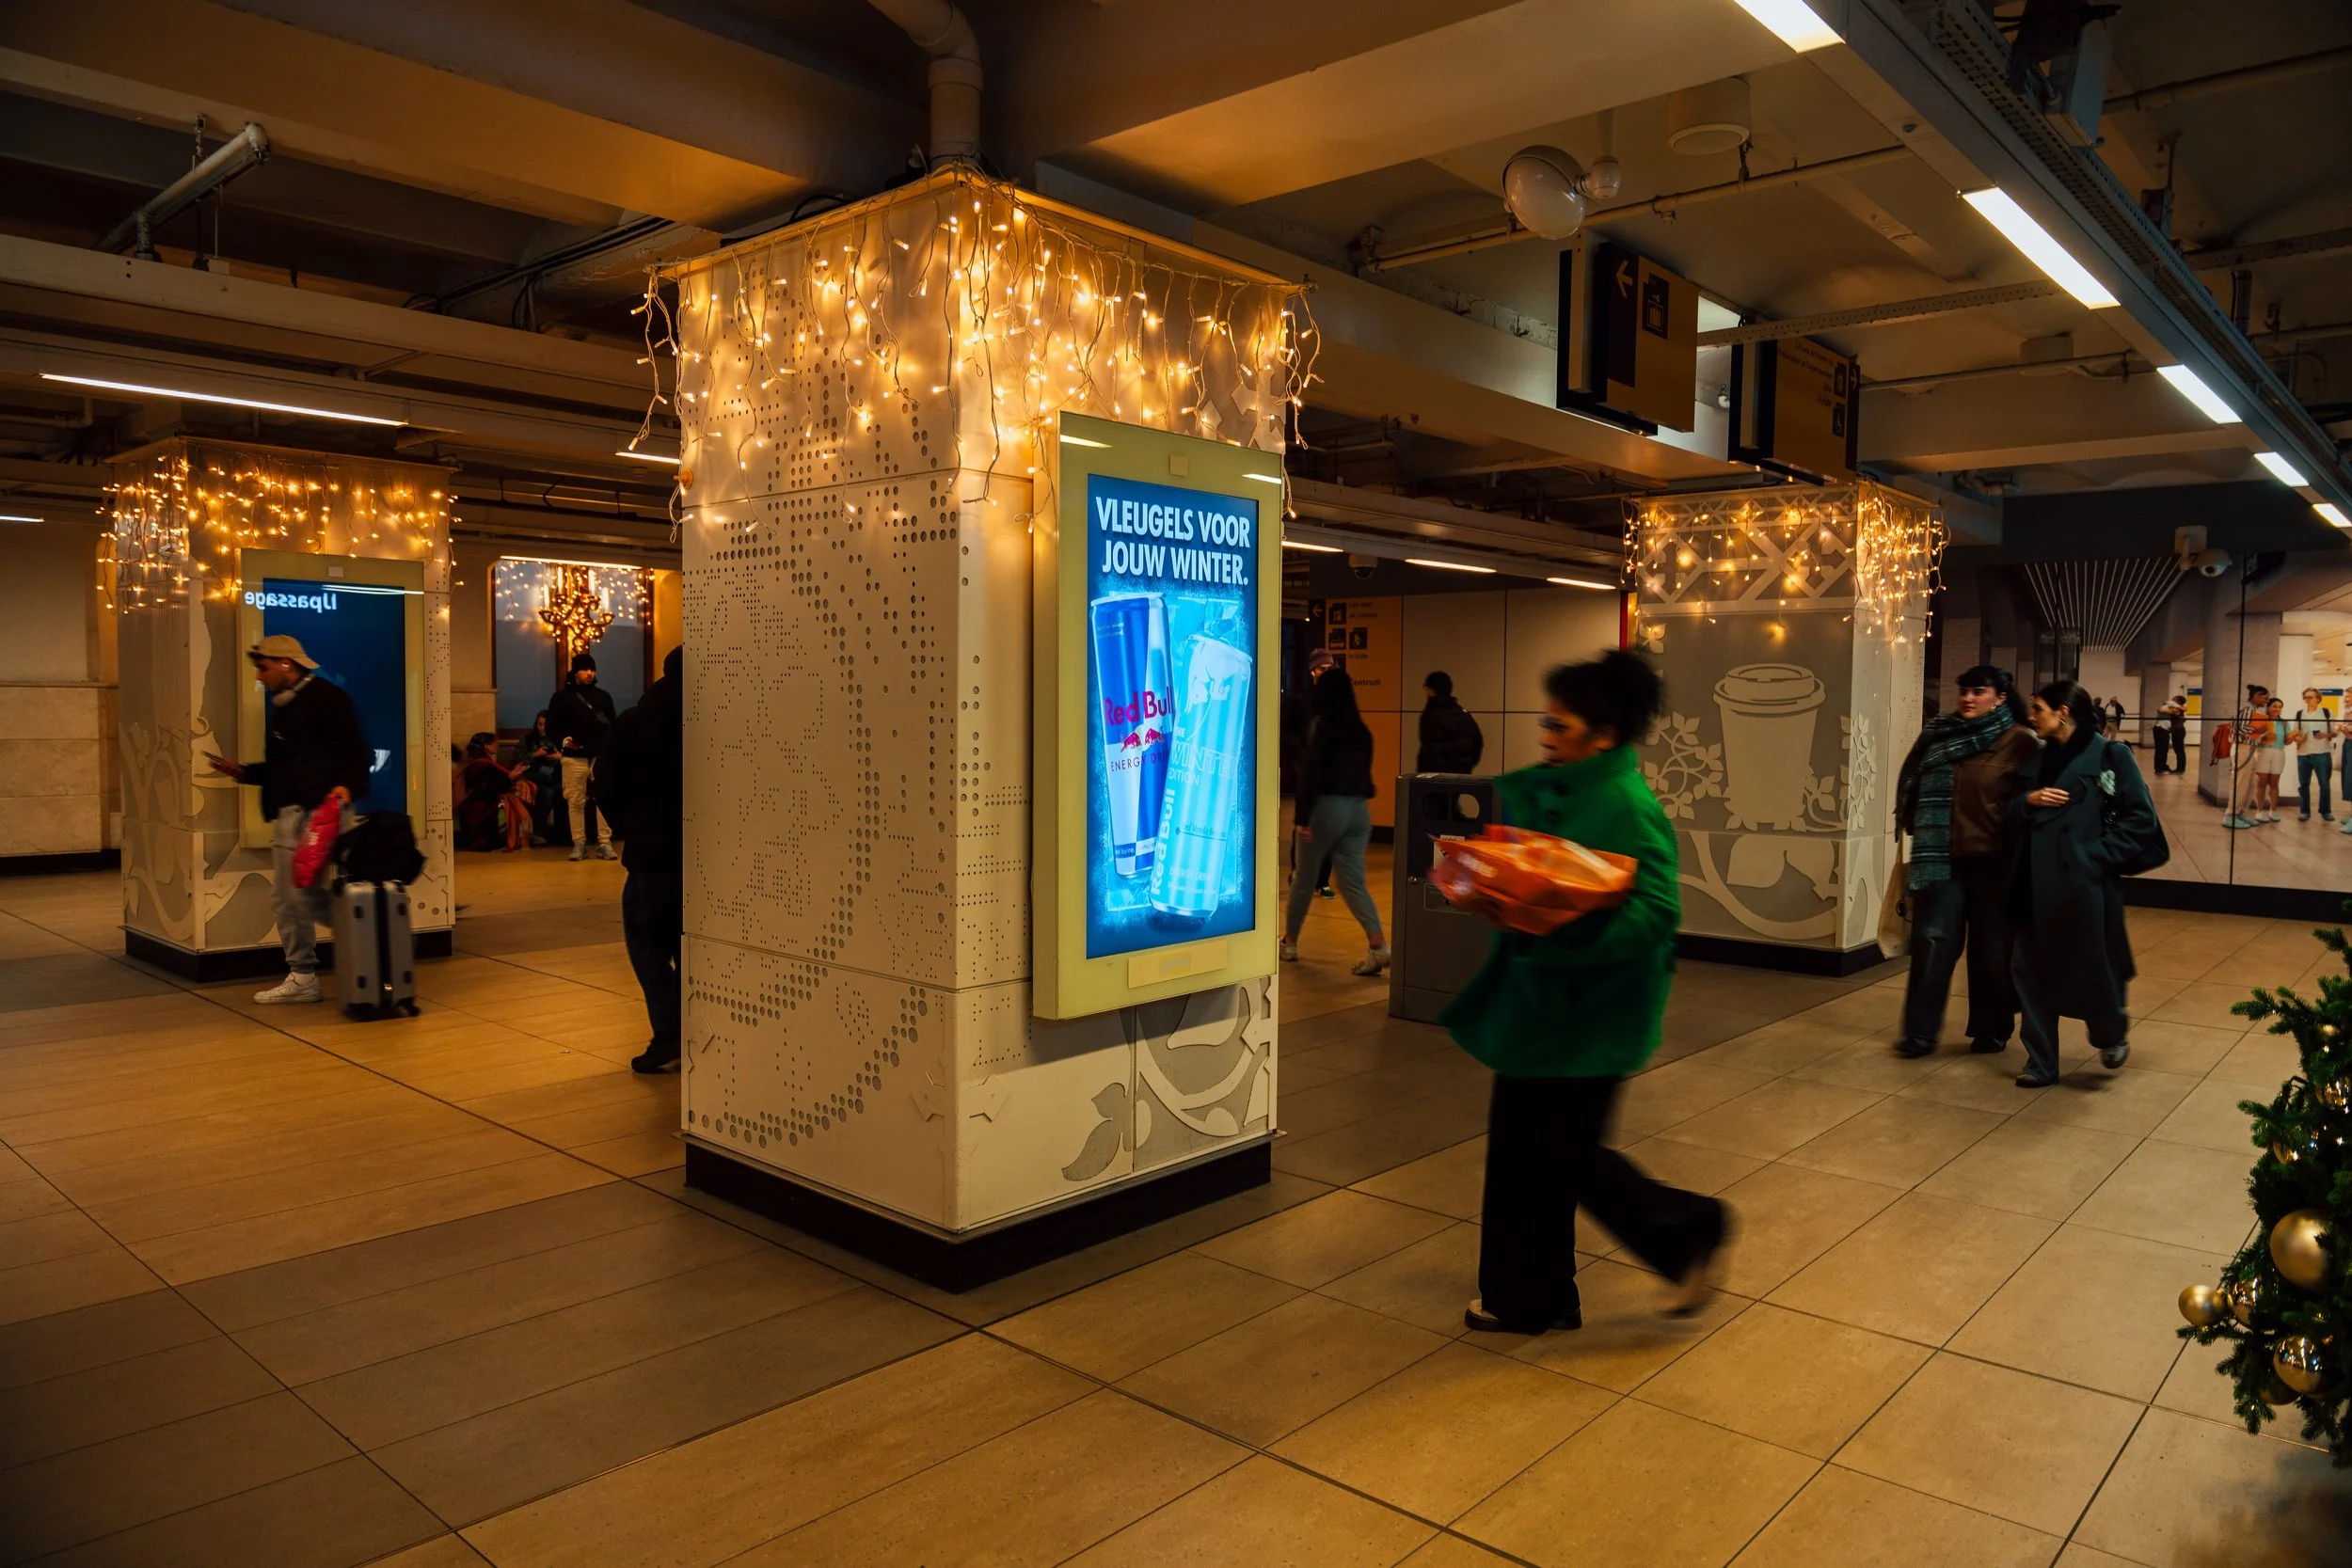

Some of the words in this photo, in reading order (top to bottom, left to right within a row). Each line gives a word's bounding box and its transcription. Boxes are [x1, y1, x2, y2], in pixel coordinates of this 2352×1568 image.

[1095, 496, 1194, 541] VLEUGELS
[1198, 511, 1250, 548] VOOR
[1102, 539, 1167, 578] JOUW
[1170, 546, 1249, 586] WINTER.
[1104, 691, 1140, 726] Red
[1142, 686, 1172, 720] Bull
[1111, 753, 1146, 772] ENERGY
[1168, 767, 1200, 786] EDITION
[1159, 788, 1175, 840] Bull
[1151, 842, 1168, 895] Red
